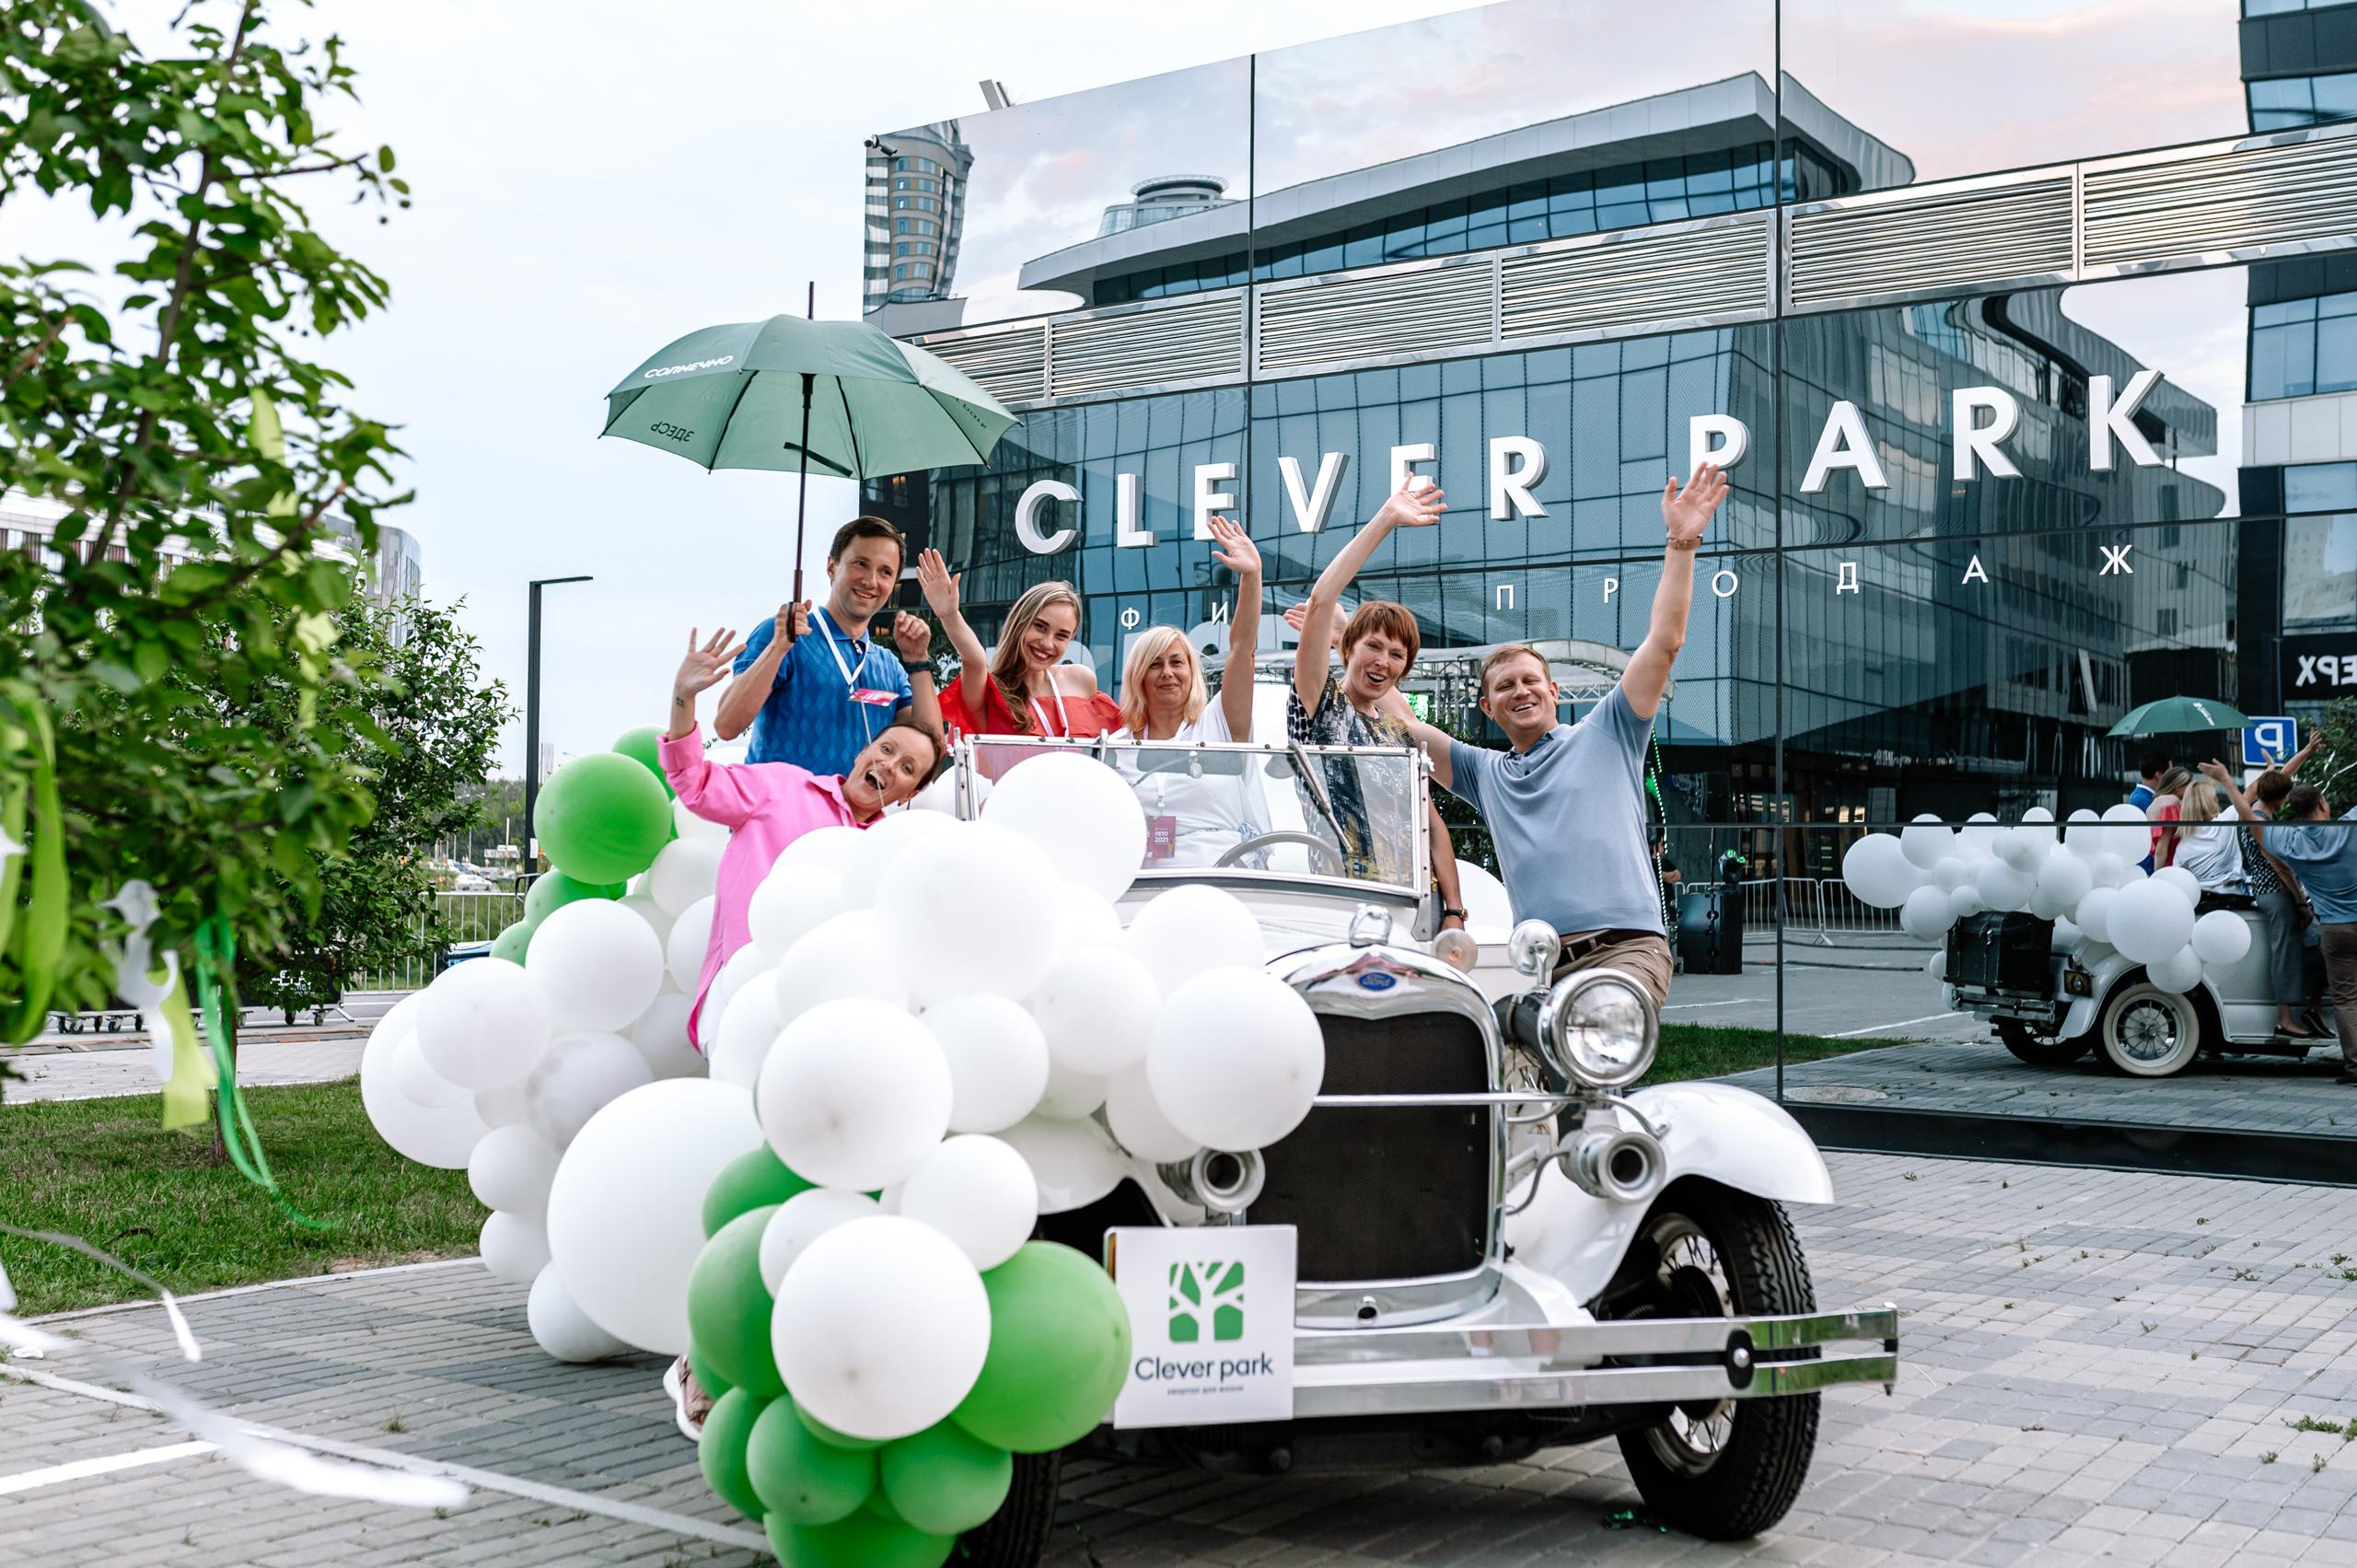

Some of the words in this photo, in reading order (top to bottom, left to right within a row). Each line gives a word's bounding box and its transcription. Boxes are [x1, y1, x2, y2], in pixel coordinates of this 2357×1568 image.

[644, 354, 735, 378] СОЛНЕЧНО
[1015, 436, 1550, 554] CLEVER
[1689, 369, 2165, 494] PARK
[1496, 544, 2133, 610] ПРОДАЖ
[1134, 1355, 1214, 1381] Clever
[1219, 1351, 1274, 1384] park
